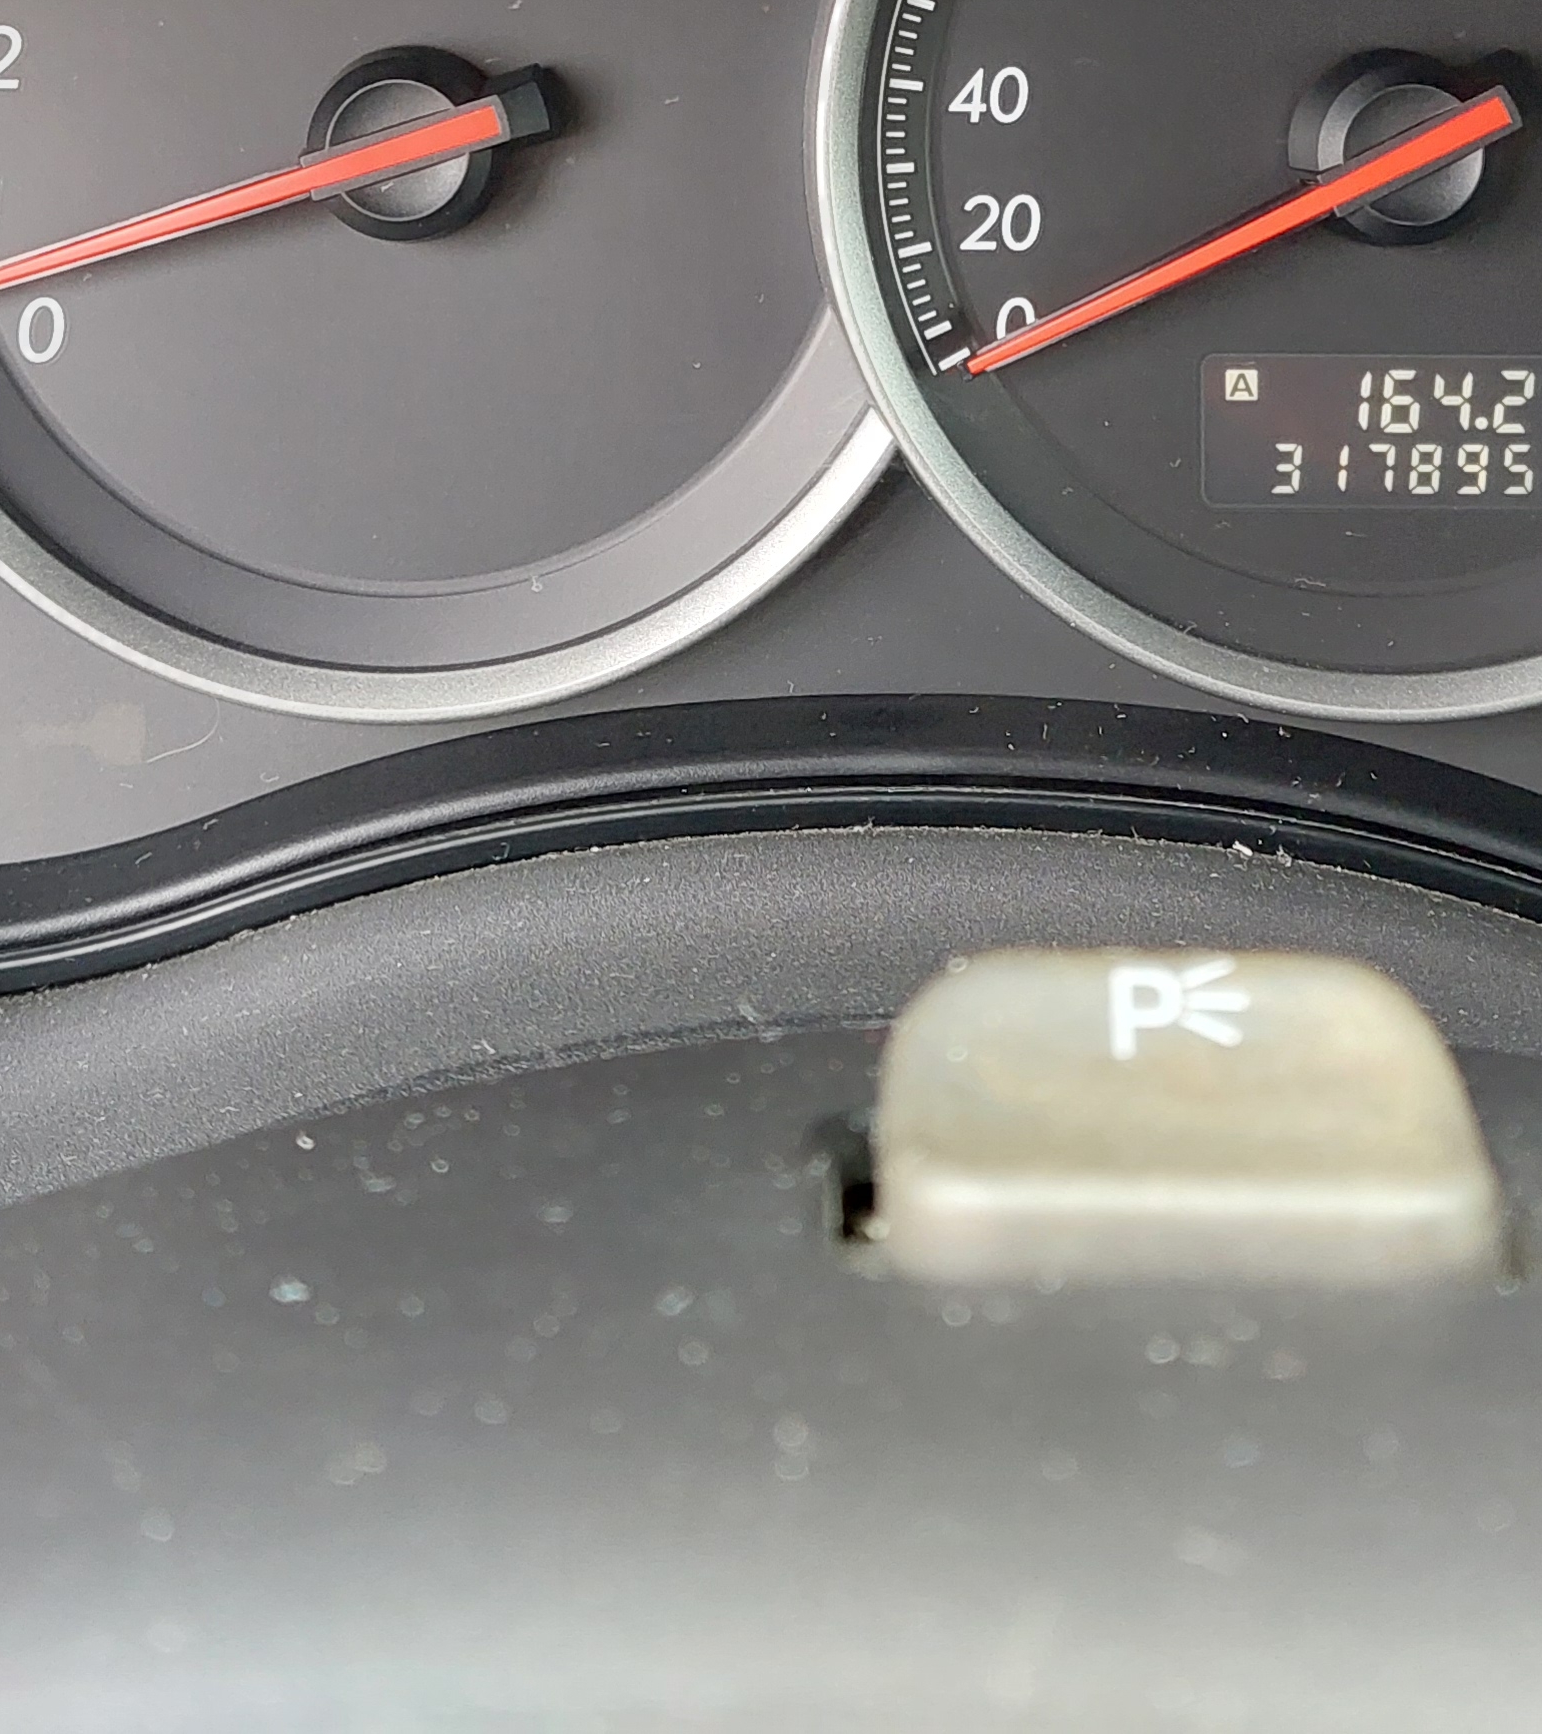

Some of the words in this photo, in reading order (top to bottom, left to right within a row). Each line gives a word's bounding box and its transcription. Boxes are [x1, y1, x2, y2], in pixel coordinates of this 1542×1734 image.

[946, 65, 1030, 125] 40
[958, 192, 1043, 253] 20
[16, 295, 66, 365] 0
[1226, 370, 1257, 400] A
[1356, 367, 1537, 435] 164.2
[1270, 442, 1535, 496] 317895
